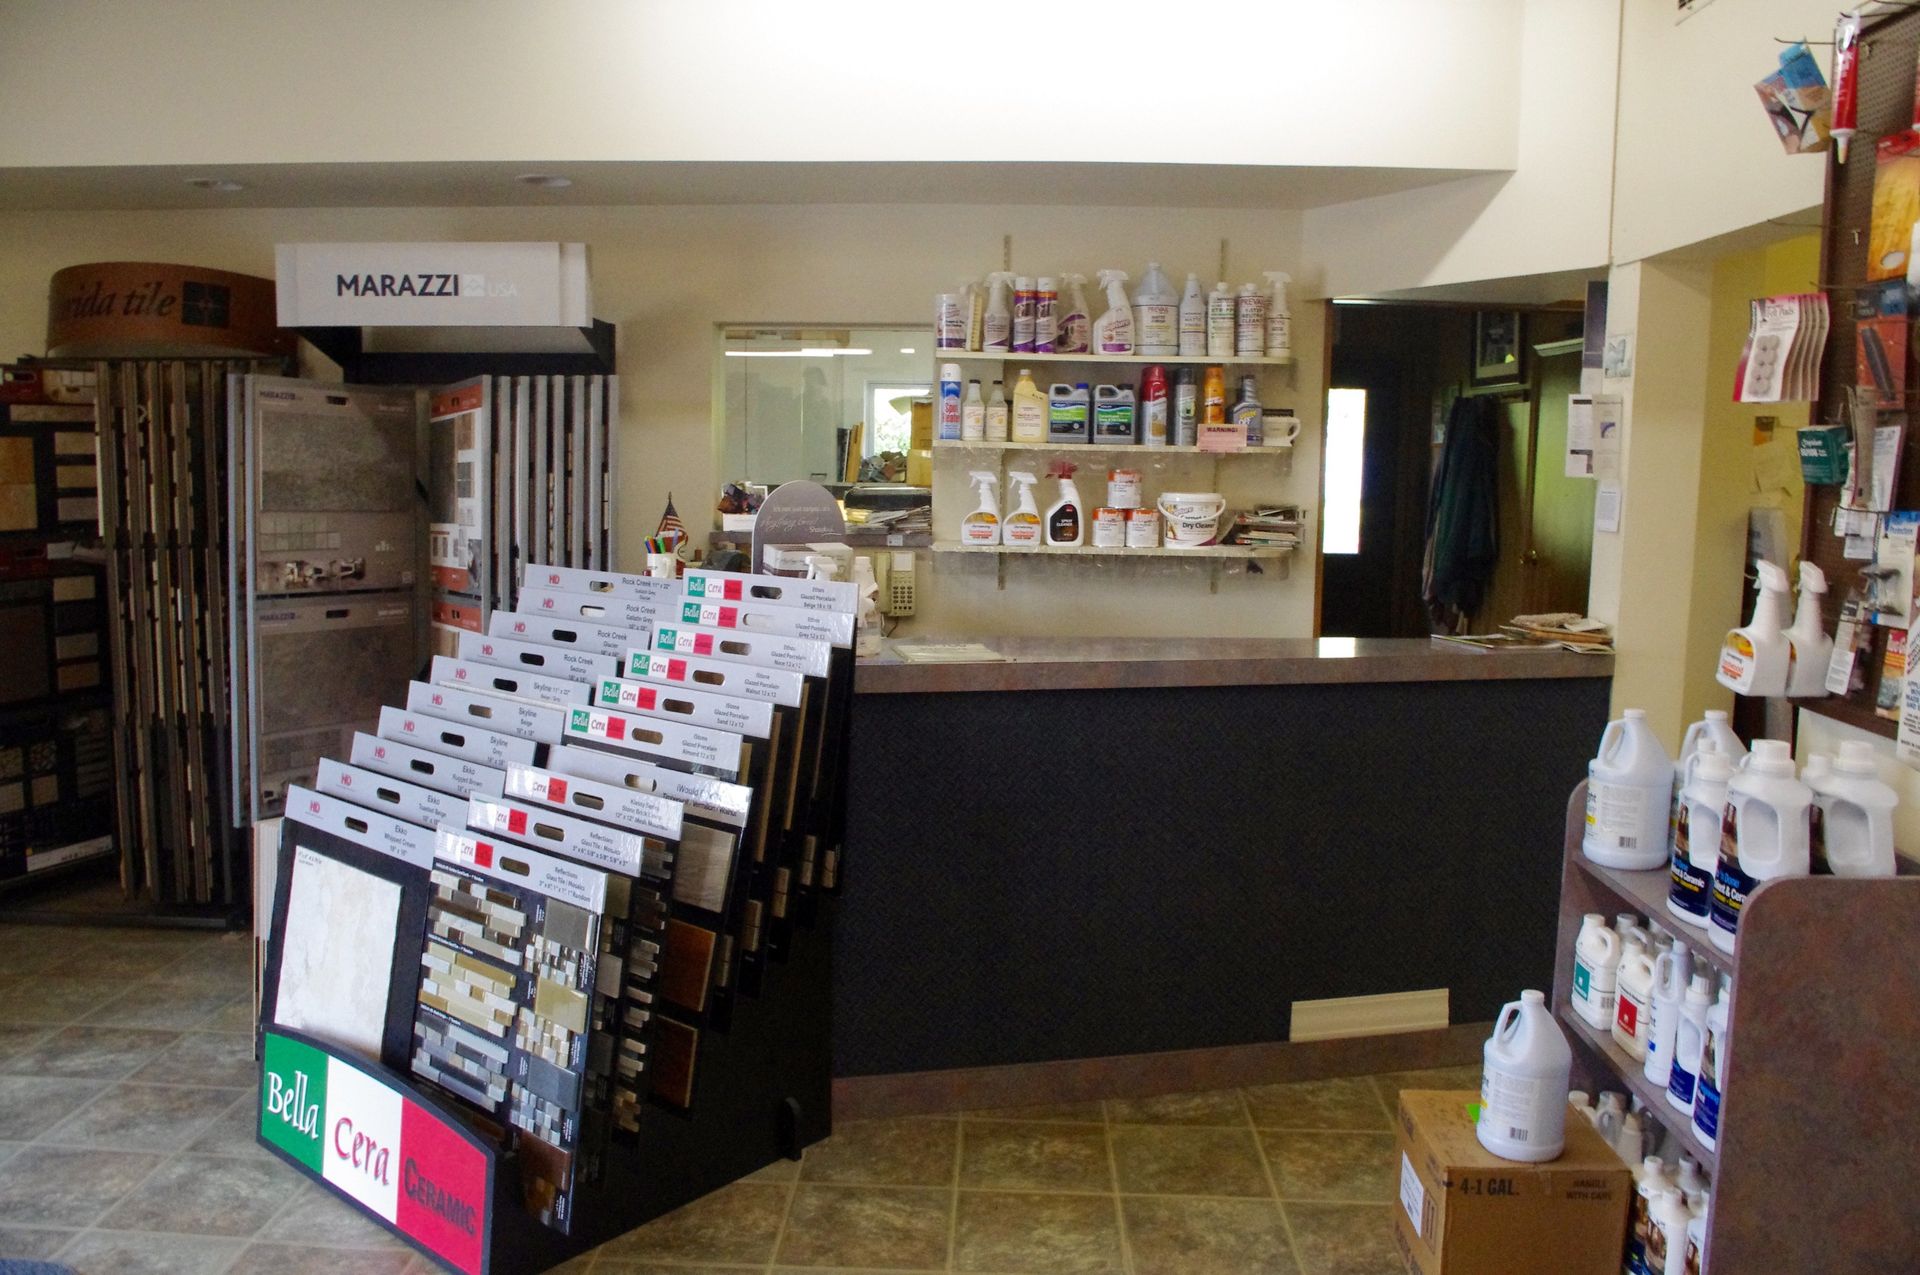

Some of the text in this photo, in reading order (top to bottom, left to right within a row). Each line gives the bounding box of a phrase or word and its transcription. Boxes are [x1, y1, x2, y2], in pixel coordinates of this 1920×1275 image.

[336, 273, 518, 297] MARAZZI USA
[123, 280, 177, 317] tile
[1182, 521, 1215, 530] Dry Cleaner
[622, 577, 652, 587] Rock Creek
[690, 579, 722, 594] Bella Cera
[641, 606, 656, 614] Creek
[684, 606, 716, 621] Bella Cera
[597, 630, 628, 641] Rock Creek
[660, 631, 692, 647] Bella Cera
[798, 632, 809, 640] Grey
[564, 654, 594, 666] Rock Creek
[786, 653, 806, 661] Porcelain
[633, 656, 666, 674] Bella Cera
[534, 682, 552, 692] Skyline
[760, 681, 780, 690] Porcelain
[603, 684, 637, 702] Bella Cera
[746, 688, 760, 696] Walnut
[518, 706, 536, 718] Skyline
[714, 709, 750, 720] Glazed Porcelain
[573, 712, 606, 732] Bella Cera
[490, 736, 508, 748] Skyline
[682, 739, 718, 752] Glazed Porcelain
[682, 748, 700, 758] Almond
[462, 765, 476, 776] Ekko
[676, 783, 699, 796] iWould
[428, 794, 440, 806] Ekko
[394, 824, 408, 836] Ekko
[400, 837, 416, 850] Cream
[581, 838, 592, 847] Glass
[590, 832, 614, 845] Reflections
[555, 866, 578, 880] Reflections
[546, 873, 558, 882] Glass
[568, 880, 586, 892] Mosaics
[1684, 871, 1705, 889] Ceramic
[267, 1070, 320, 1141] Bella
[334, 1117, 390, 1187] Cera
[1460, 1178, 1520, 1196] 4-1 GAL.
[1566, 1190, 1612, 1200] WITH CARE
